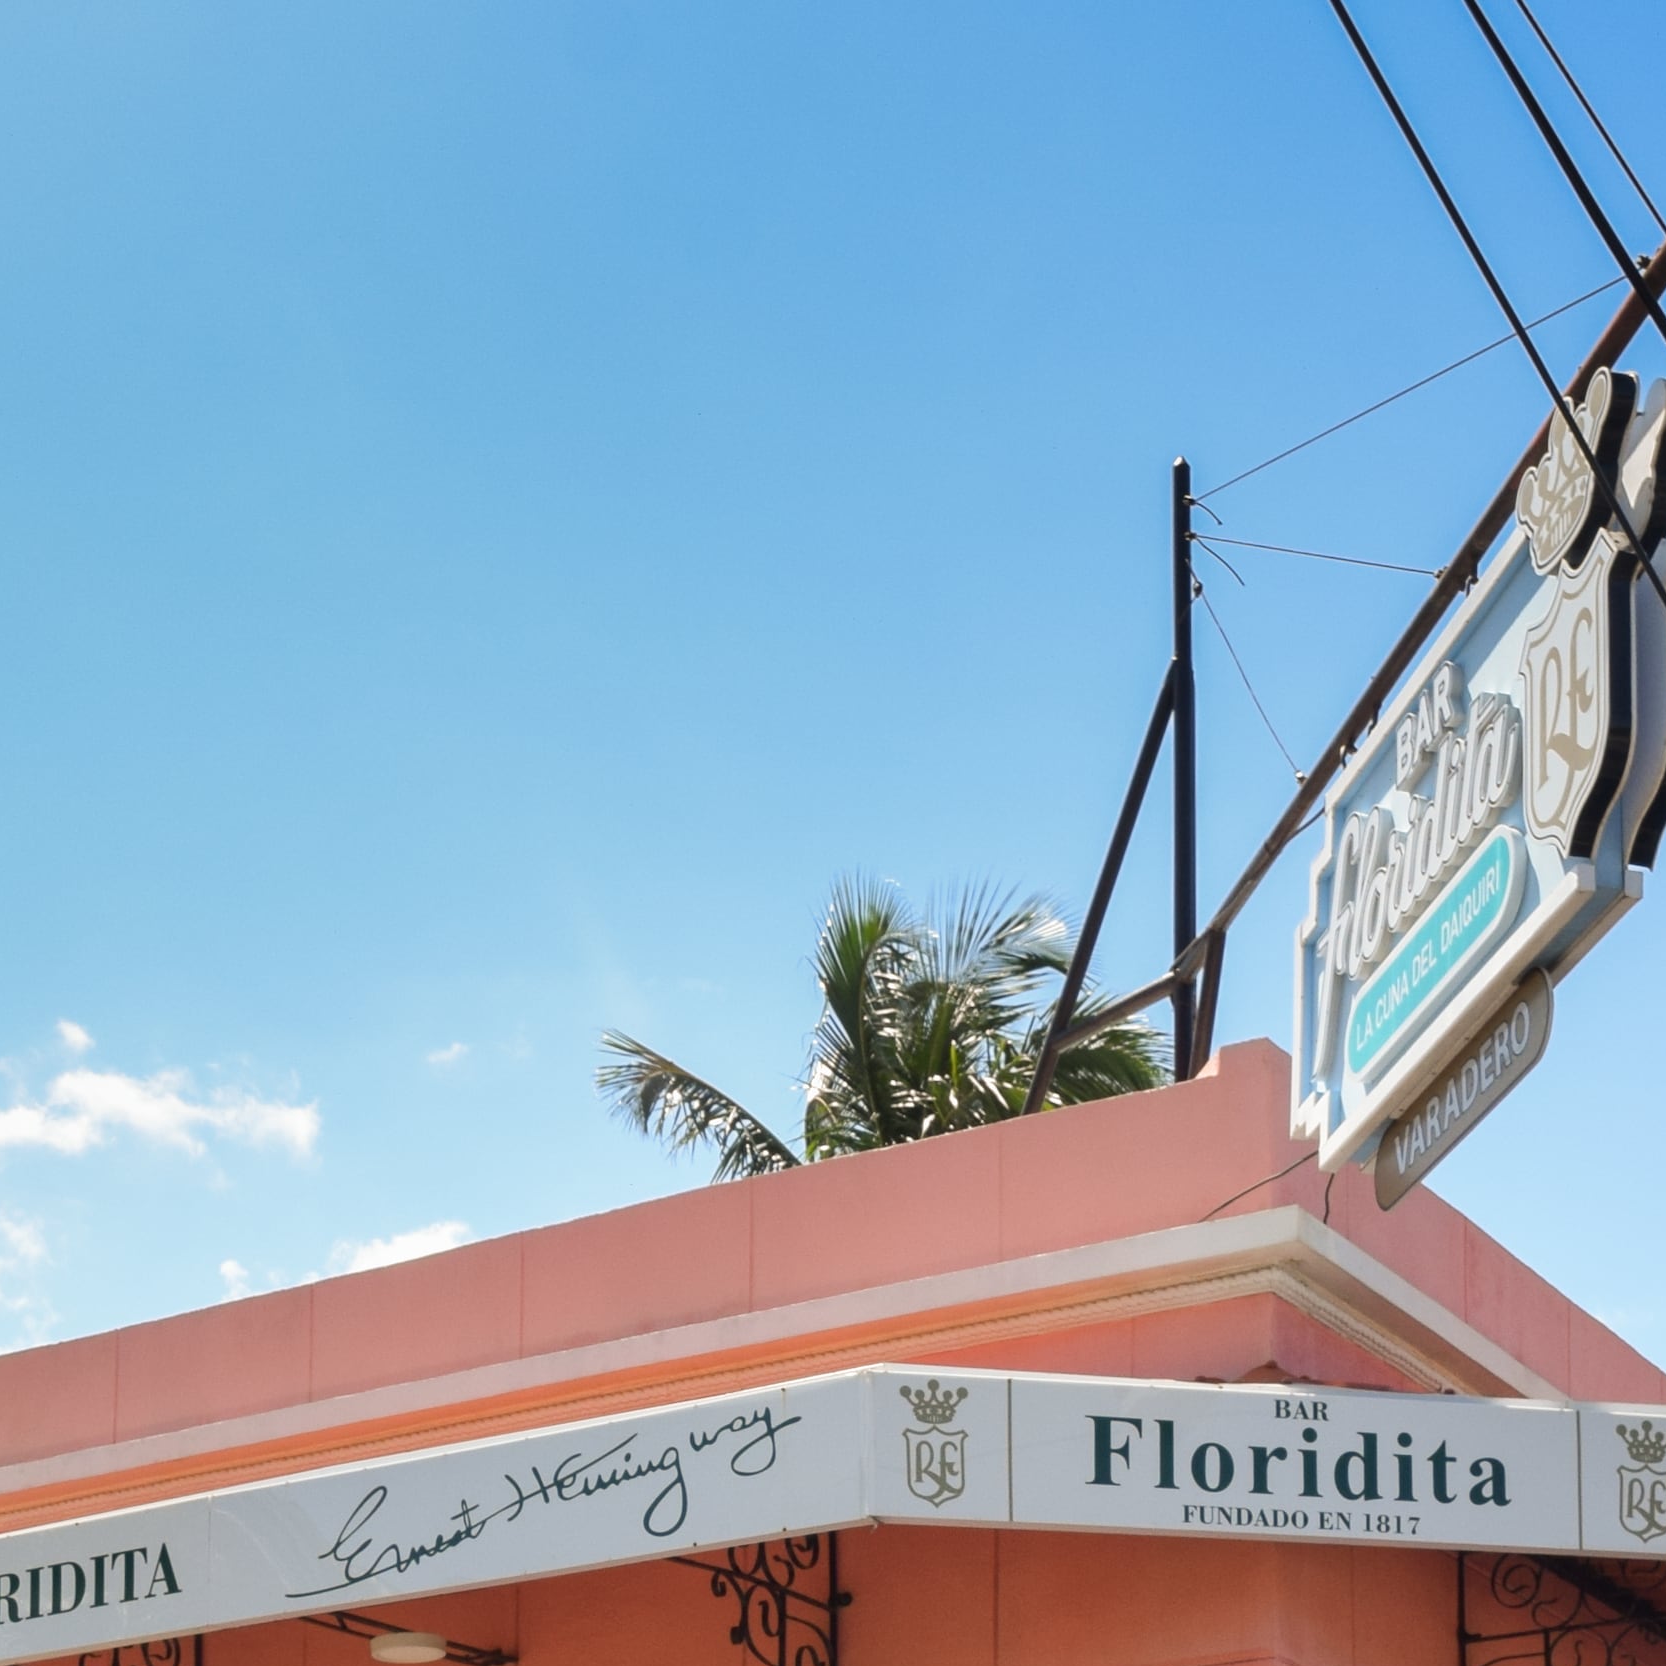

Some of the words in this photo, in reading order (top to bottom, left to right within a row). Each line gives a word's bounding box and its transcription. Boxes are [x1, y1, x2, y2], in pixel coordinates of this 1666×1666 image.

[1396, 662, 1454, 790] BAR
[1356, 1013, 1373, 1050] LA
[1375, 971, 1409, 1027] CUNA
[1412, 939, 1437, 986] DEL
[1393, 1000, 1531, 1176] VARADERO
[1274, 1399, 1329, 1421] BAR
[1084, 1415, 1512, 1507] Floridita
[1182, 1504, 1309, 1530] FUNDADO
[1318, 1512, 1352, 1531] EN
[1363, 1513, 1421, 1536] 1817
